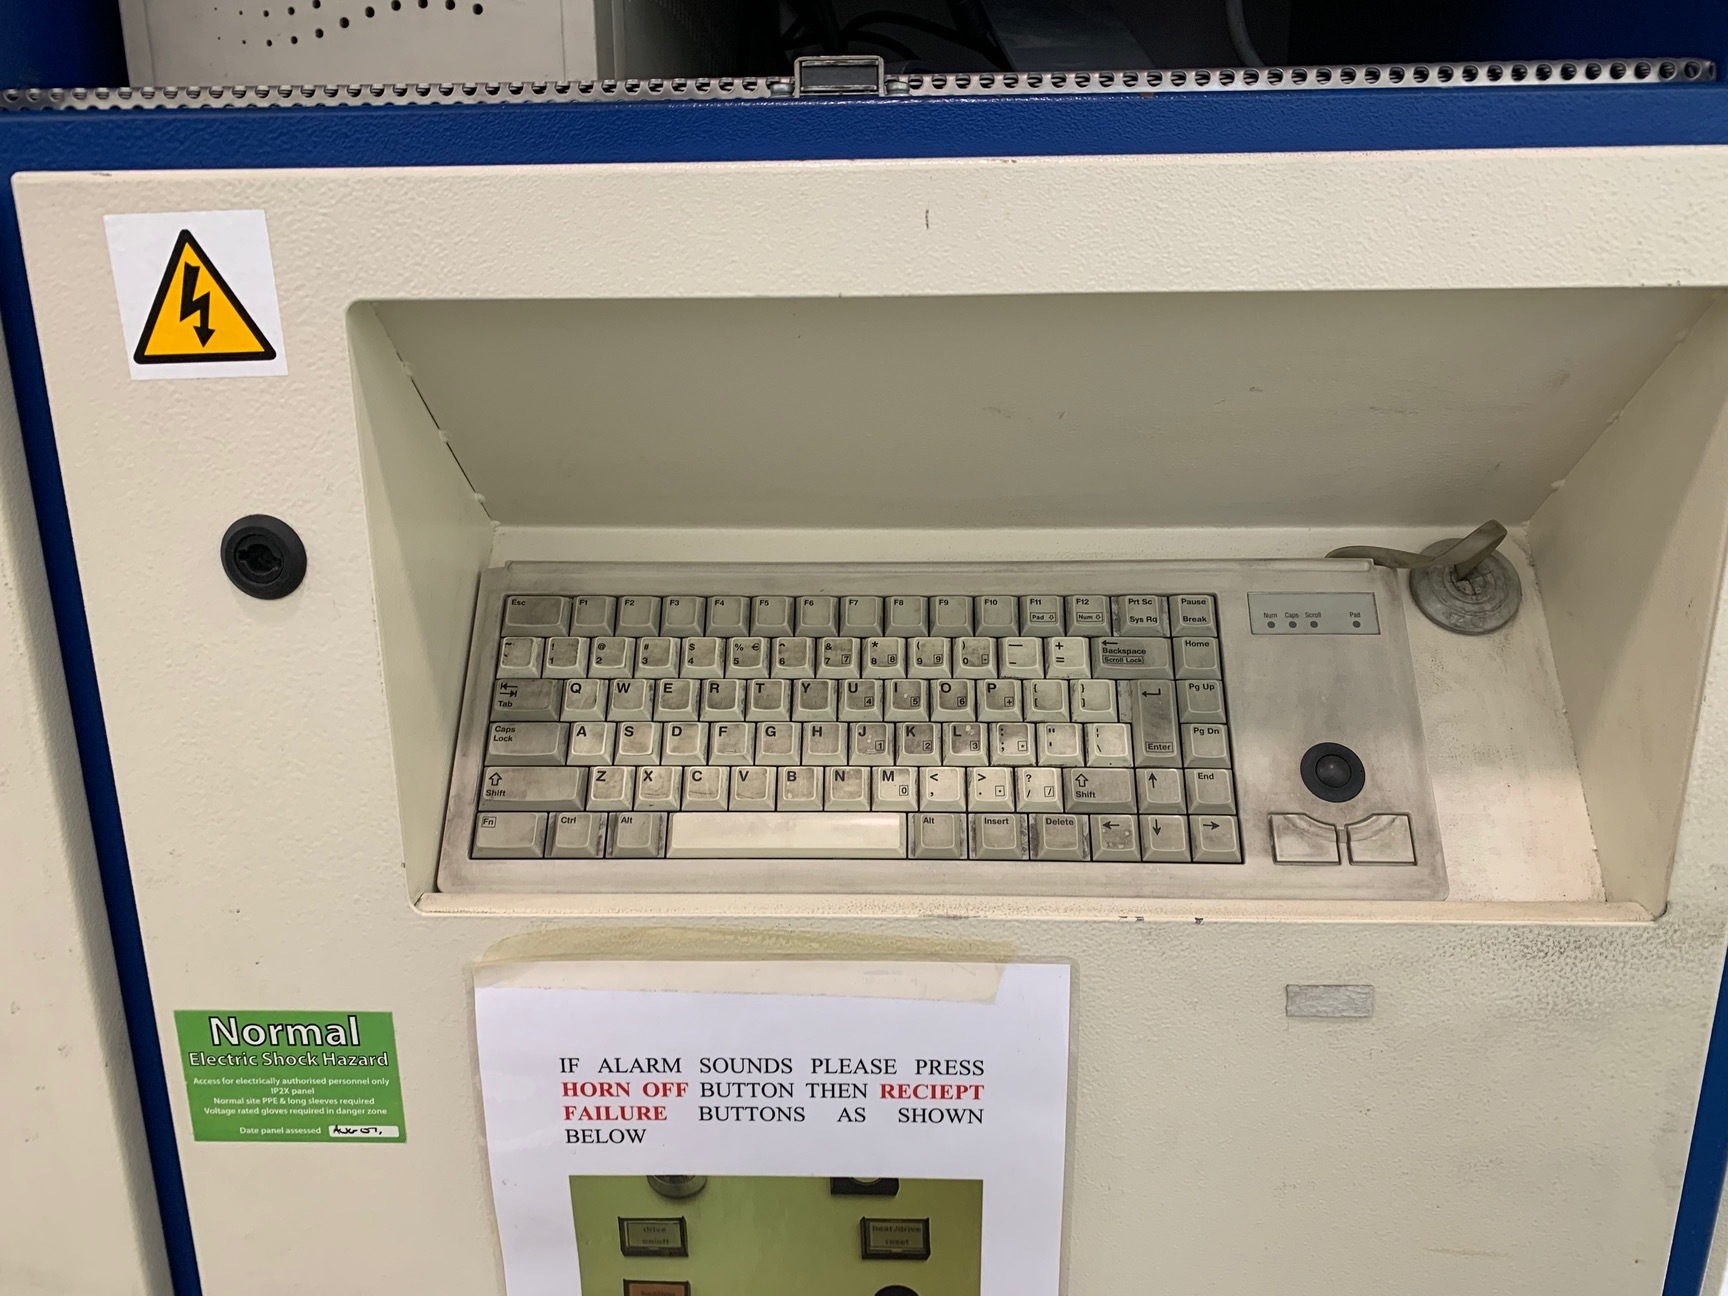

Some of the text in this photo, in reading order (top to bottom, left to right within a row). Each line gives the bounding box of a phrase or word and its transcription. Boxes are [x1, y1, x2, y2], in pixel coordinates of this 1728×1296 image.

[1129, 616, 1158, 624] Sys Rq
[1284, 612, 1299, 620] Caps
[1102, 647, 1147, 656] Backspace
[570, 683, 582, 693] Q
[617, 683, 631, 693] W
[663, 683, 673, 693] E
[709, 683, 720, 693] R
[755, 683, 765, 693] T
[801, 683, 811, 693] Y
[848, 683, 858, 693] U
[940, 683, 952, 693] O
[987, 683, 997, 693] P
[1189, 683, 1215, 691] Pg Up
[576, 726, 587, 737] A
[624, 726, 634, 737] S
[671, 726, 682, 736] D
[718, 726, 728, 737] F
[765, 726, 777, 737] G
[812, 726, 822, 737] H
[858, 726, 866, 737] J
[906, 726, 916, 737] K
[953, 726, 962, 737] L
[1193, 727, 1220, 736] Pg Dn
[1147, 743, 1171, 751] Enter
[596, 771, 607, 781] Z
[643, 771, 654, 781] X
[691, 771, 703, 781] C
[739, 771, 749, 781] V
[787, 771, 797, 781] B
[834, 771, 845, 781] N
[882, 770, 895, 781] M
[485, 789, 506, 797] Shift
[1075, 790, 1096, 798] Shift
[483, 818, 494, 826] Fn
[560, 816, 577, 824] Ctrl
[620, 816, 633, 824] Alt
[984, 817, 1009, 825] Insert
[208, 1015, 361, 1047] Normal
[188, 1051, 390, 1067] Electric Shock Hazard
[559, 1057, 985, 1076] IF ALARM SOUNDS PLEASE PRESS
[193, 1077, 390, 1086] Access for electrically authorised personnel only
[270, 1087, 315, 1096] IP2X panel
[562, 1081, 985, 1100] HORN OFF BUTTON THEN RECIEPT
[213, 1097, 244, 1105] Normal
[246, 1097, 261, 1105] site
[262, 1097, 278, 1105] PPE
[287, 1097, 307, 1106] long
[308, 1097, 338, 1105] sleeves
[339, 1097, 375, 1106] required
[203, 1107, 236, 1116] Voltage
[237, 1107, 260, 1115] rated
[261, 1107, 288, 1116] gloves
[289, 1107, 324, 1116] required
[336, 1107, 366, 1116] danger
[563, 1105, 984, 1124] FAILURE BUTTONS AS SHOWN
[239, 1127, 321, 1136] Date panel assessed
[565, 1128, 647, 1145] BELOW
